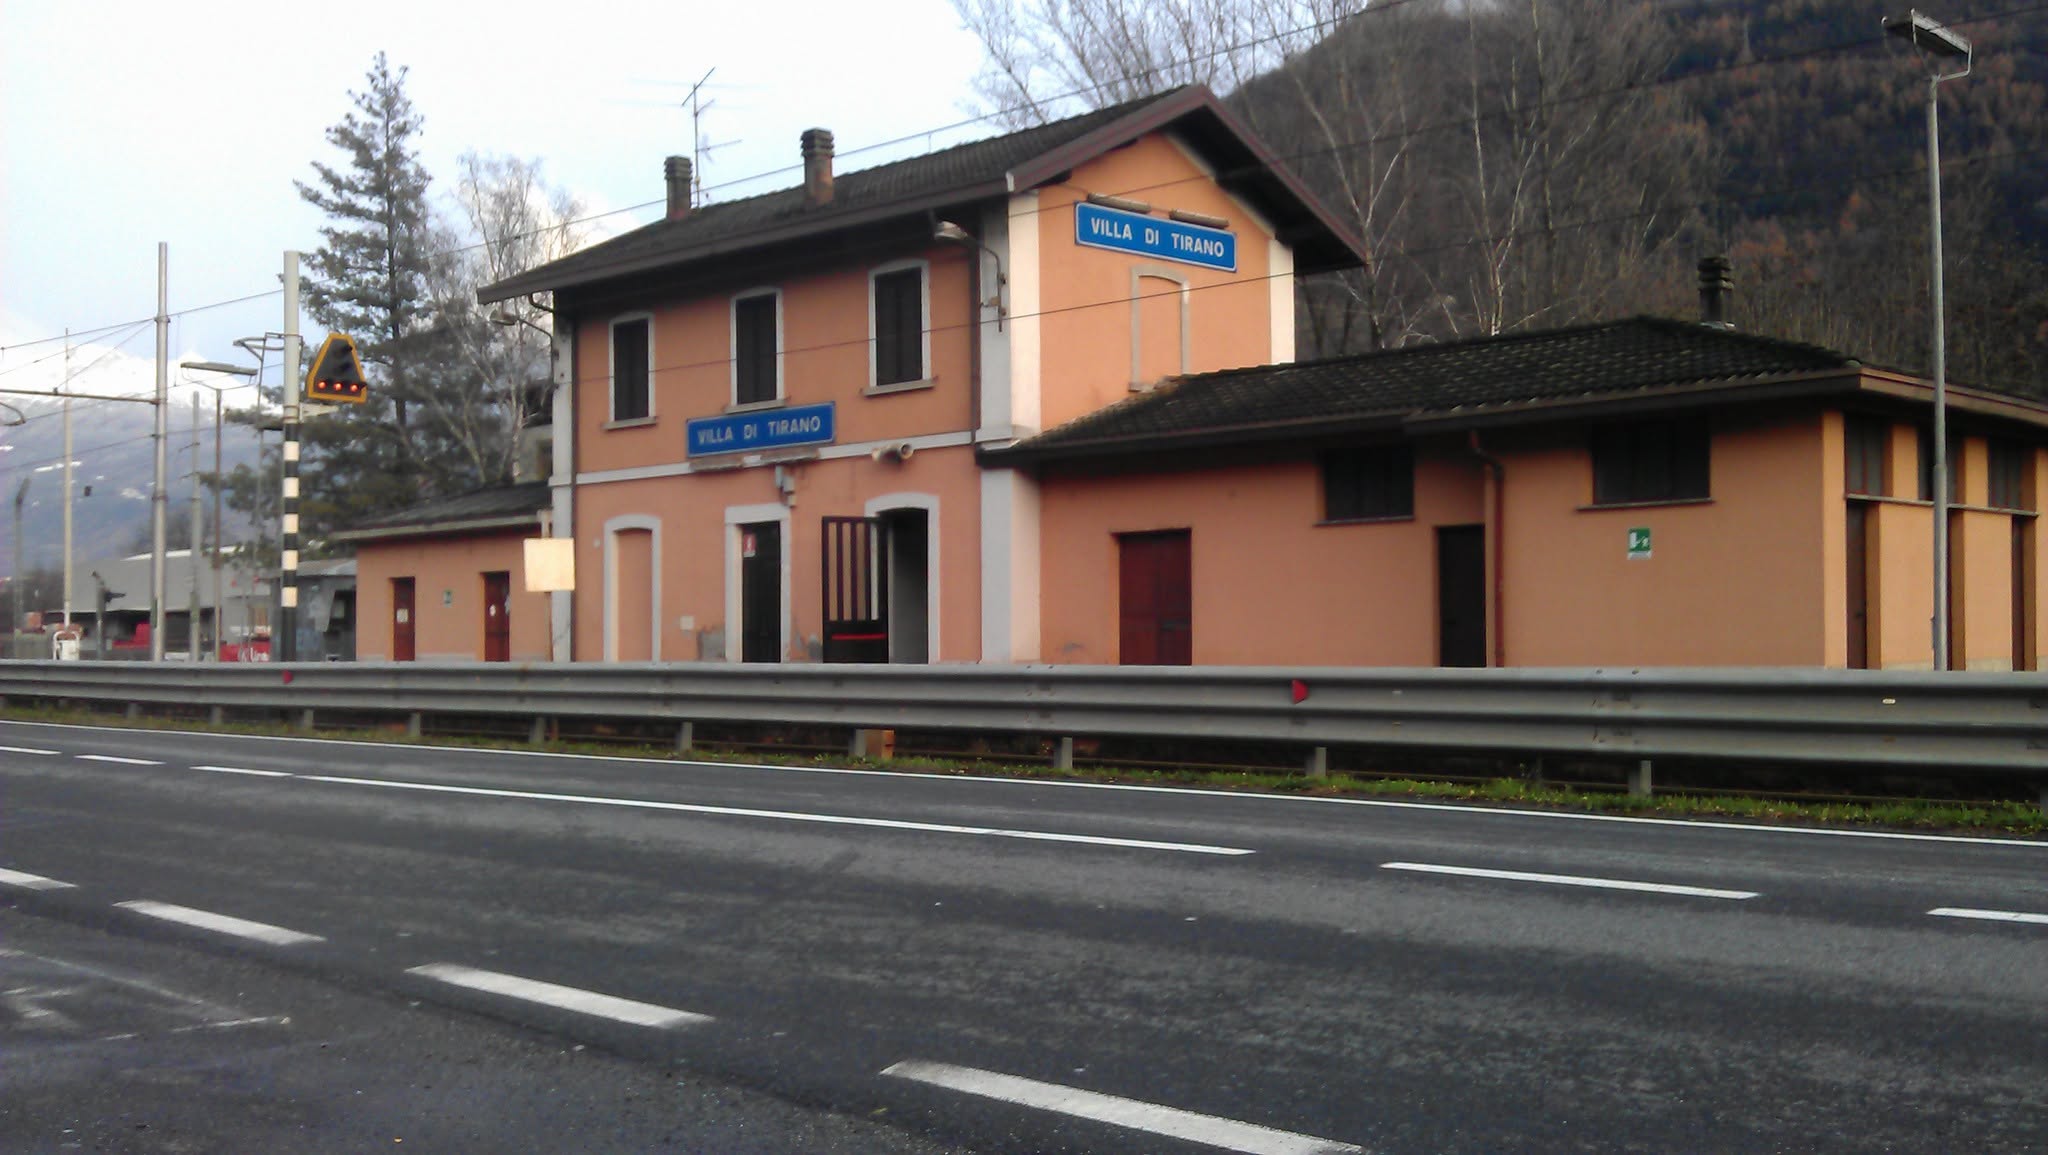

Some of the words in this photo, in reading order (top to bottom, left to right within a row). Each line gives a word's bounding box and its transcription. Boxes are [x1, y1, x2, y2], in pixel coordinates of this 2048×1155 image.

[1091, 217, 1132, 240] VILLA
[1145, 228, 1159, 245] DI
[1171, 233, 1224, 257] TIRANO
[697, 427, 733, 445] VILLA
[744, 424, 757, 440] DI
[768, 416, 821, 437] TIRANO
